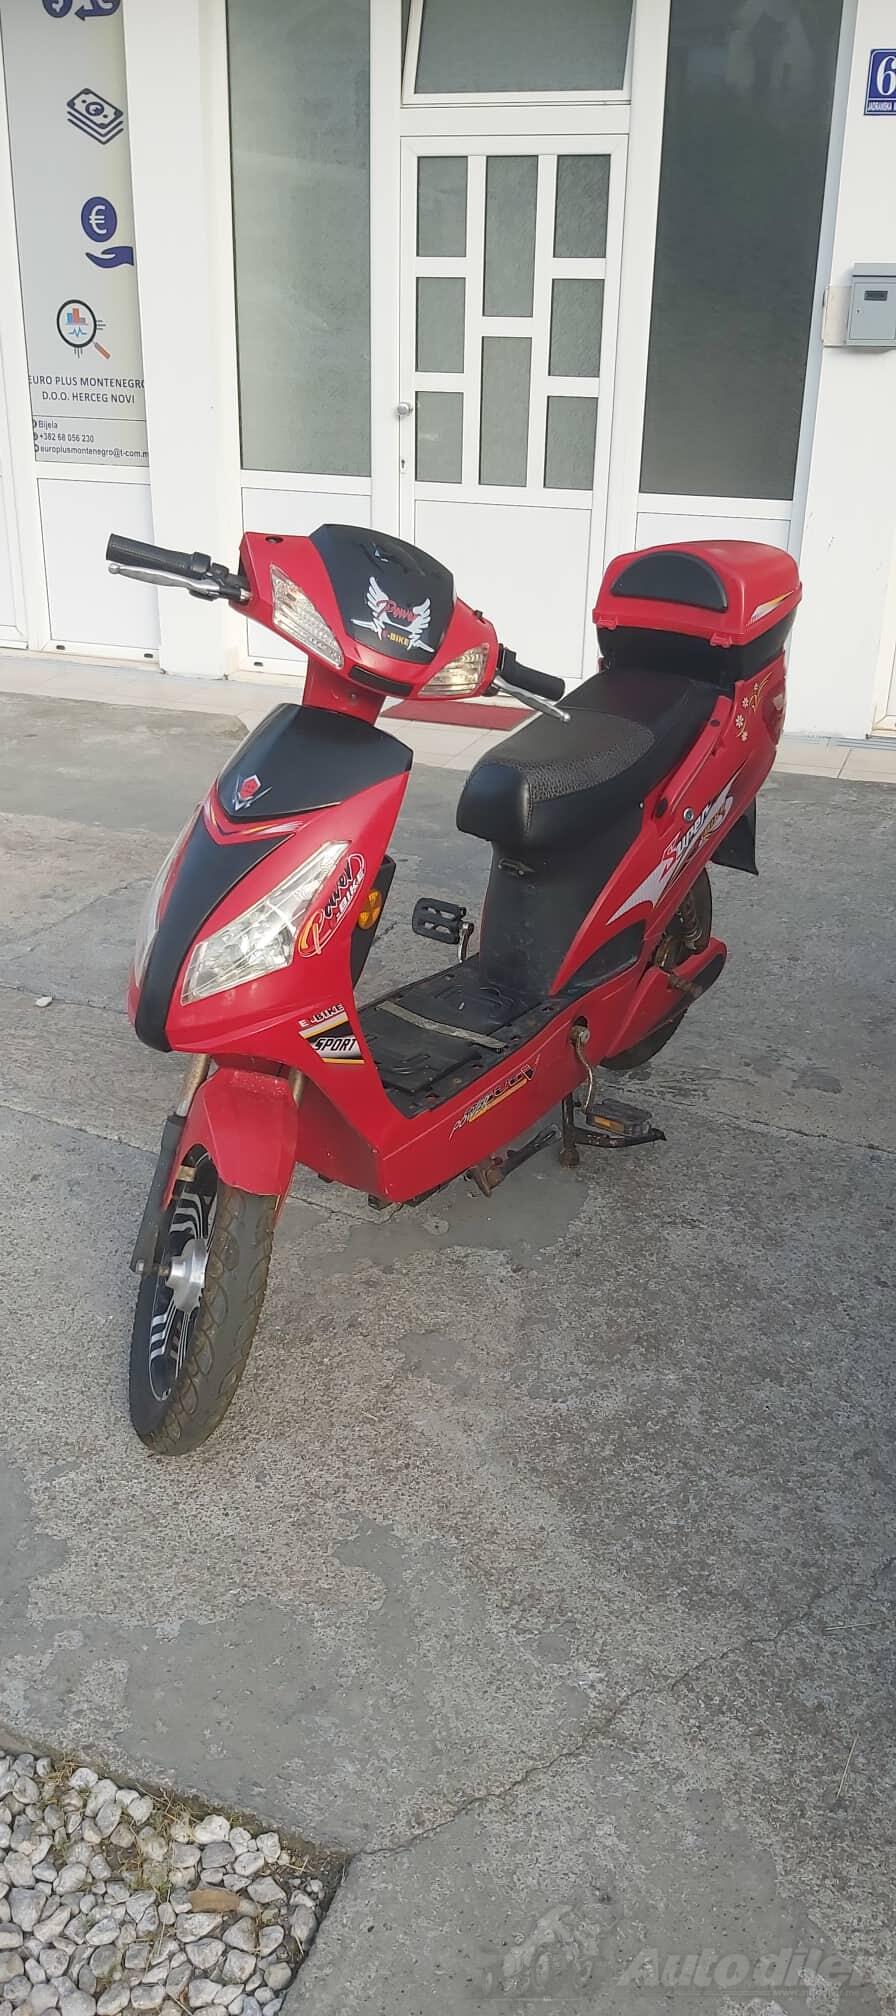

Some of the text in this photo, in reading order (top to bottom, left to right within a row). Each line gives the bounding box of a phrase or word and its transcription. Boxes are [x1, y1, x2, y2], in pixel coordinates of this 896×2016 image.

[55, 376, 78, 386] PLUS
[42, 391, 135, 404] D.O.O. HERCEG NOVI
[38, 420, 58, 430] Bijela
[39, 433, 56, 441] +382
[57, 433, 66, 442] 68
[81, 435, 95, 443] 230
[314, 1038, 358, 1051] SPORT
